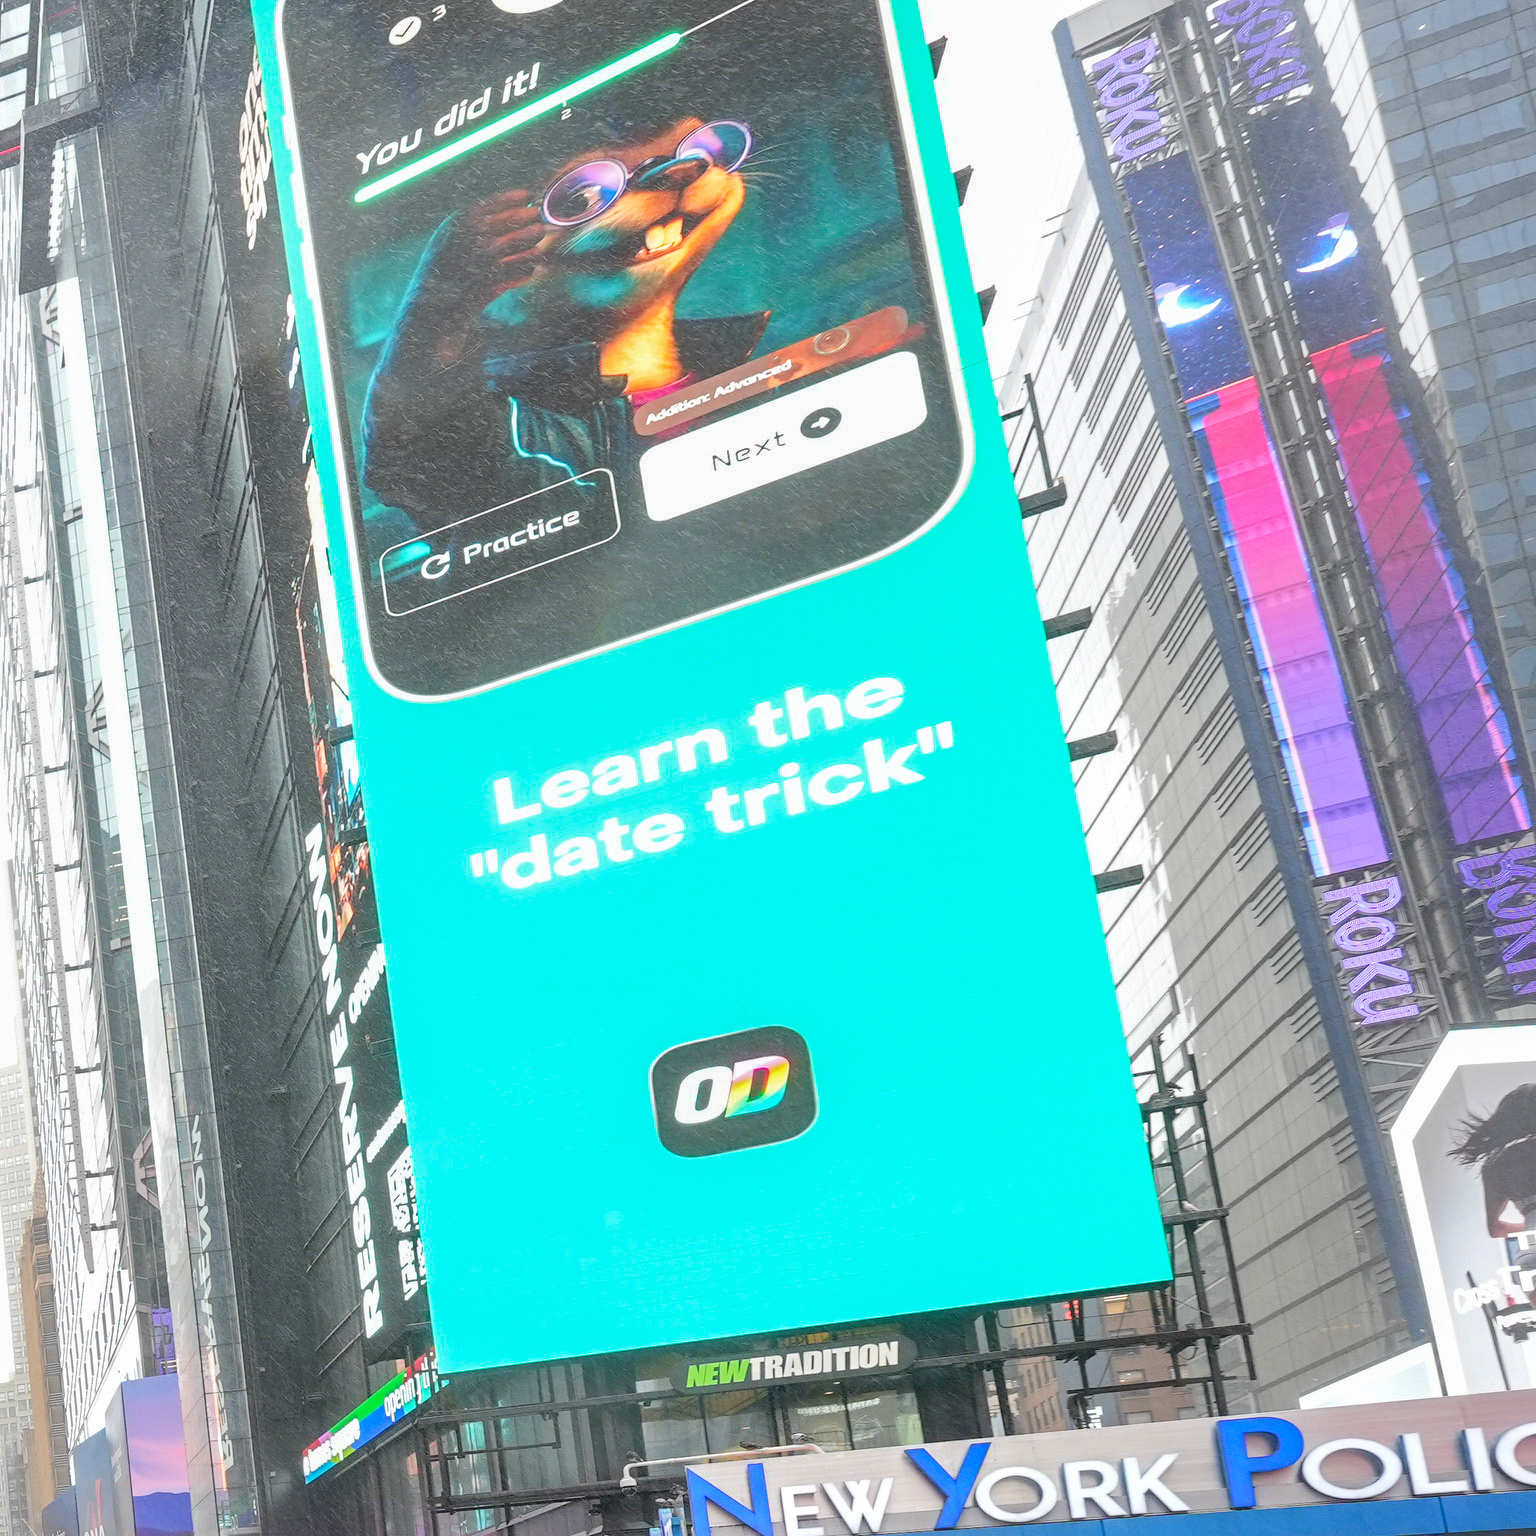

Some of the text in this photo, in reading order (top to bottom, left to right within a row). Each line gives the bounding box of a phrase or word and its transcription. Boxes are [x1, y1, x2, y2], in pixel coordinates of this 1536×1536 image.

[356, 62, 541, 175] You did it!
[645, 359, 793, 426] Addition: Advanced
[712, 430, 787, 472] Next
[463, 510, 580, 565] Practice
[469, 721, 954, 892] "date trick"
[493, 676, 906, 826] Learn the
[330, 1012, 384, 1339] RESERVE
